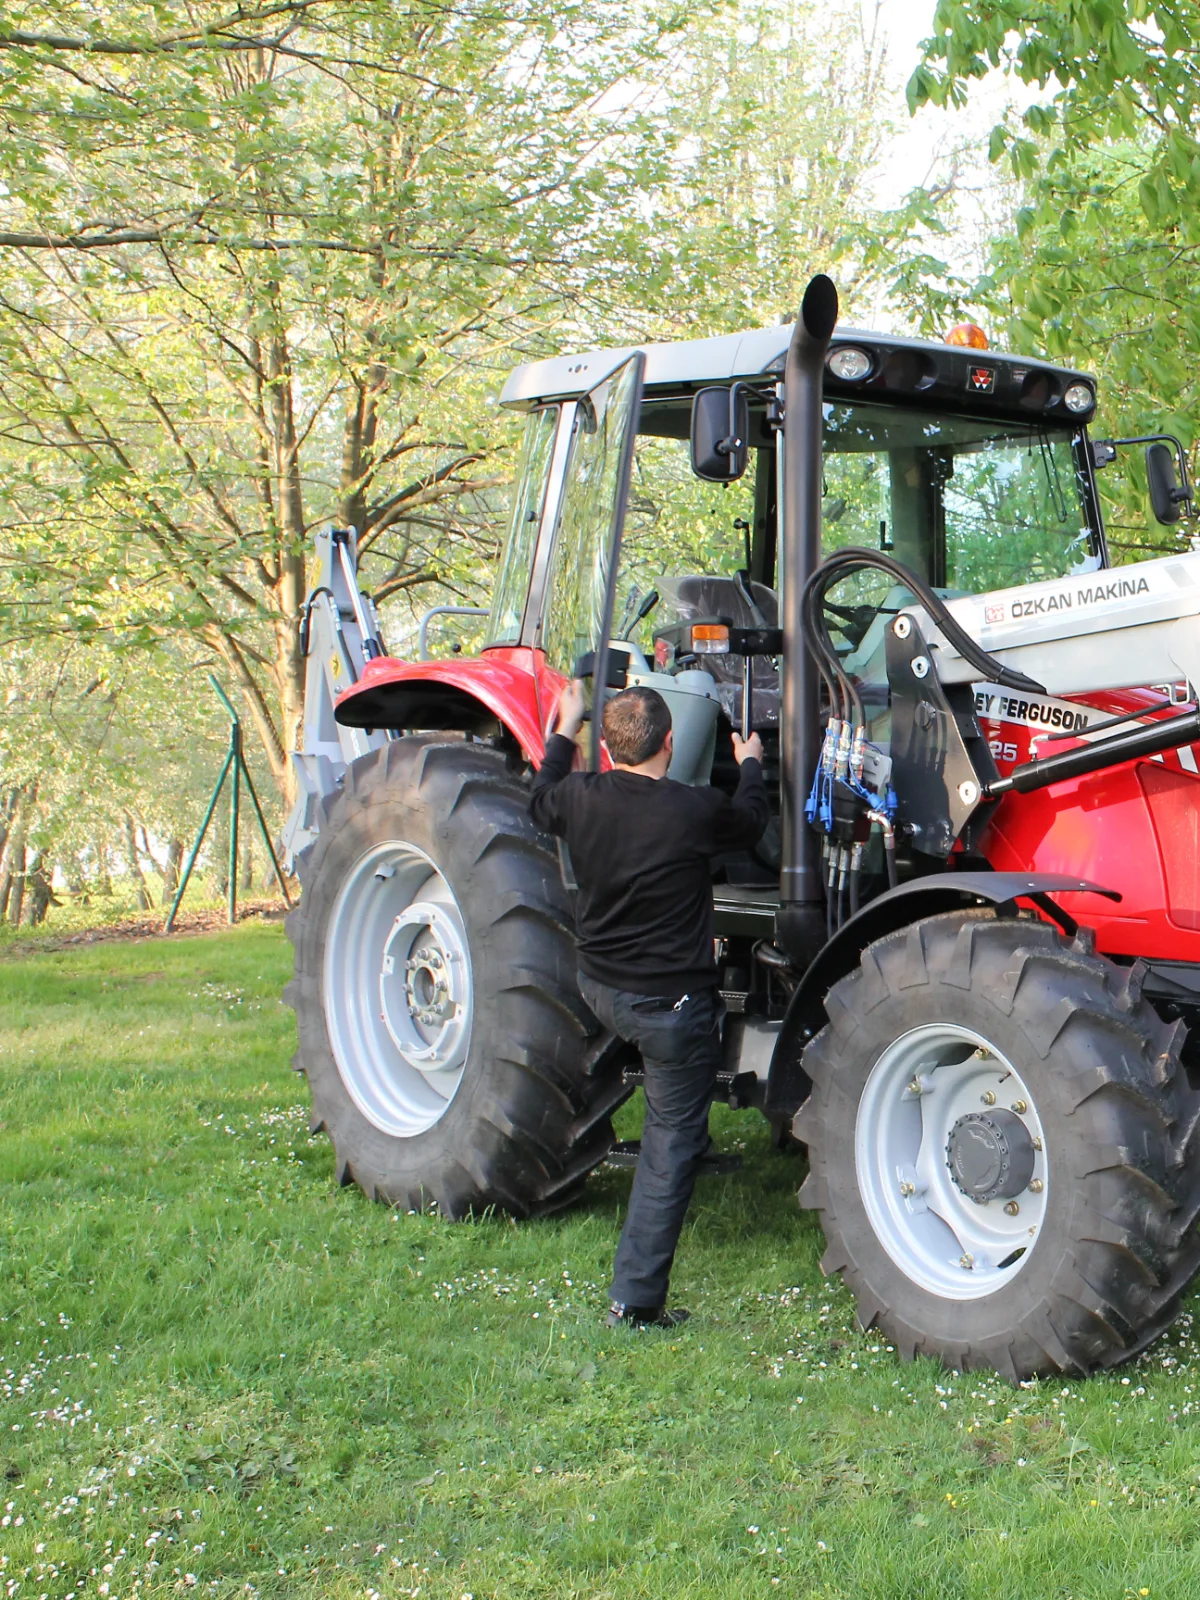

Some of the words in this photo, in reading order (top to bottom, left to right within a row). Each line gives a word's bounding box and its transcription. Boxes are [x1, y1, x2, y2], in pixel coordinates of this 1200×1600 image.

[1011, 593, 1072, 618] ÖZKAN
[1077, 578, 1150, 606] MAKİNA
[999, 697, 1089, 730] FERGUSON
